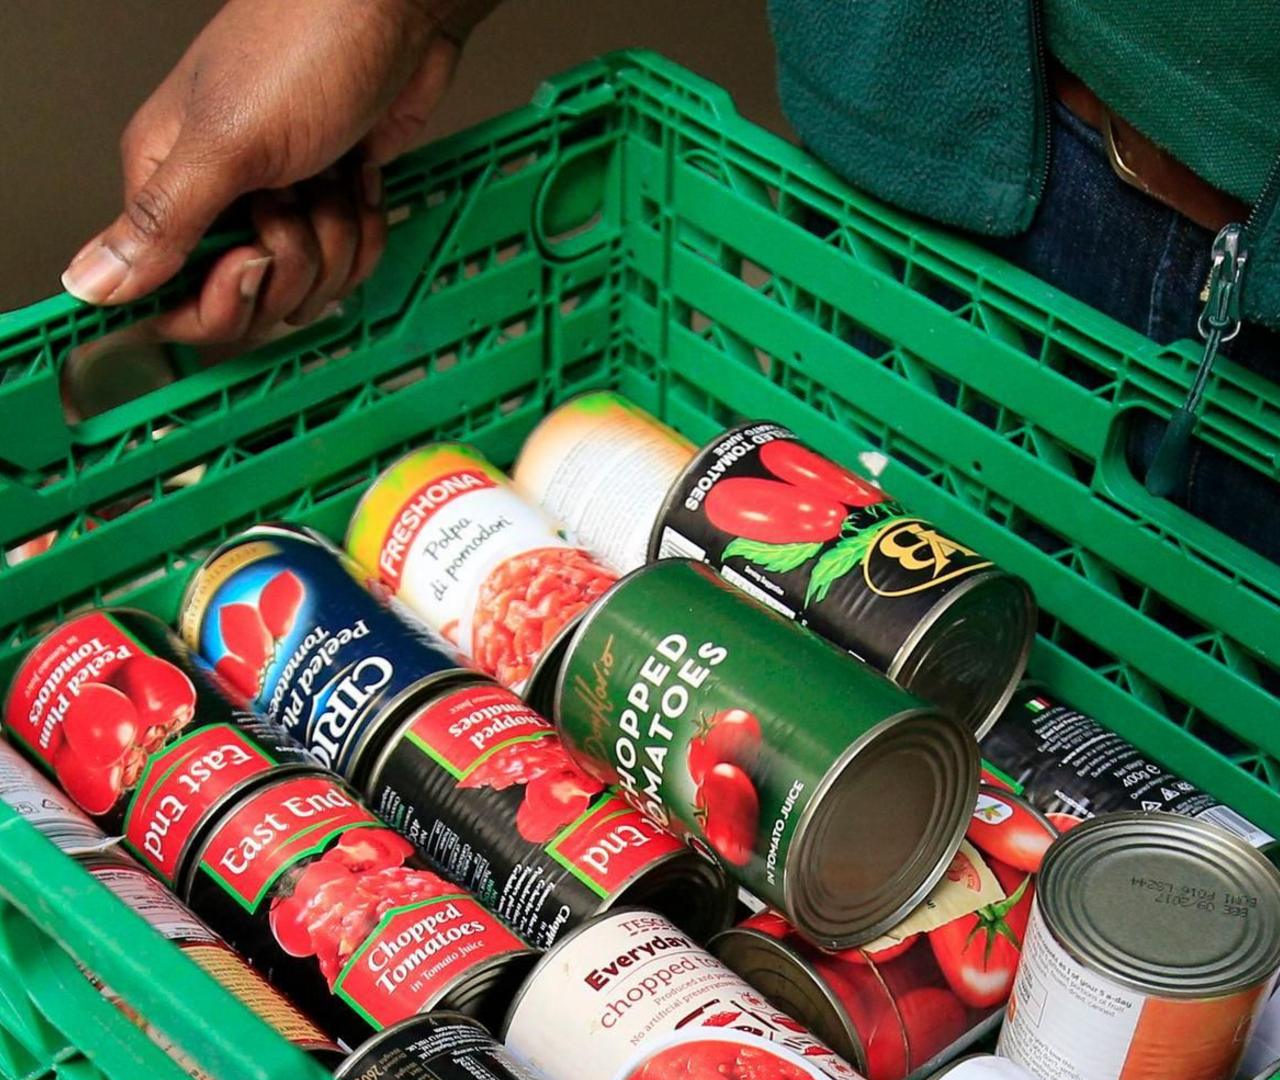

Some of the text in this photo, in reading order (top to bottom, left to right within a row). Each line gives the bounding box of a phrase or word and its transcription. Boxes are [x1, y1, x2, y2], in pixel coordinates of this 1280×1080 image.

[685, 441, 751, 512] TOMATOES
[379, 472, 483, 576] FRESHONA
[424, 517, 472, 562] Polpa
[433, 516, 514, 601] di pomodori
[28, 638, 106, 726] Tomatoes
[39, 645, 132, 749] Peeled Plum
[269, 625, 330, 715] Tomatoes
[281, 619, 370, 729] Peeled Plu
[616, 633, 688, 811] CHOPPED
[640, 640, 728, 834] TOMATOES
[178, 743, 253, 794] East
[144, 795, 188, 863] End
[221, 813, 288, 876] East
[283, 789, 352, 818] End
[581, 824, 651, 874] End
[767, 780, 805, 887] IN TOMATO JUICE
[367, 904, 463, 973] Chopped
[374, 920, 485, 994] Tomatoes
[410, 979, 421, 993] in
[421, 952, 459, 982] Tomato
[584, 933, 690, 992] Everyday
[601, 957, 696, 1029] chopped
[631, 1032, 645, 1046] No
[644, 1001, 683, 1033] artificial
